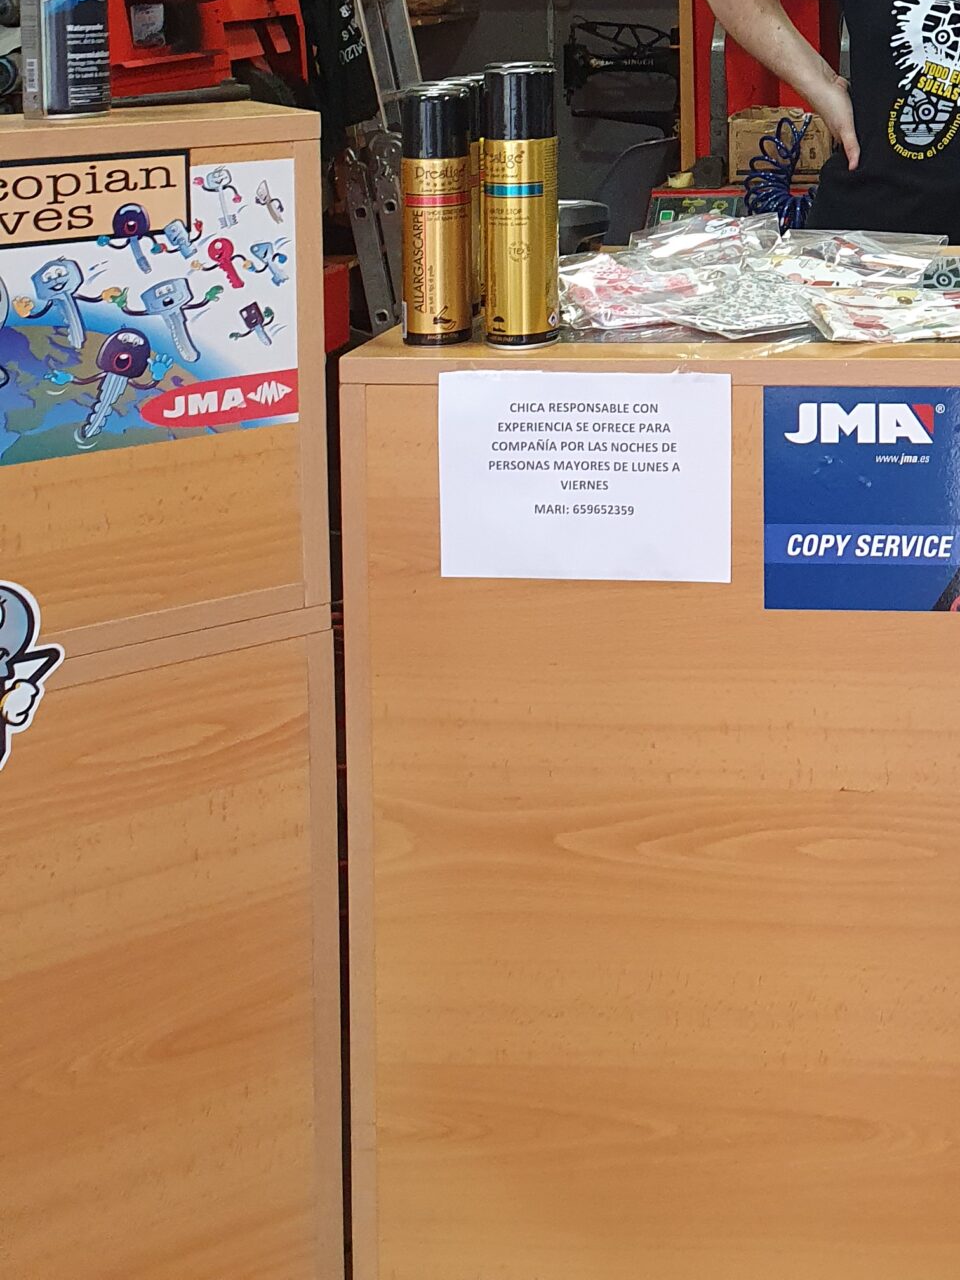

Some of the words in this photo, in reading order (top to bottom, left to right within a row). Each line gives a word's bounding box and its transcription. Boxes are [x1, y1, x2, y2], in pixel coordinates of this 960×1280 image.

[924, 60, 950, 81] TODO
[917, 76, 960, 101] SUELAS
[887, 111, 897, 145] pisada
[894, 143, 925, 160] marca
[926, 147, 937, 158] el
[0, 205, 94, 235] ves
[412, 210, 425, 314] ALLARGASCARPE
[163, 388, 247, 418] JMA
[509, 402, 545, 413] CHICA
[548, 402, 630, 414] RESPONSABLE
[632, 403, 658, 414] CON
[497, 422, 573, 432] EXPERIENCIA
[575, 422, 589, 432] SE
[592, 422, 636, 433] OFRECE
[638, 423, 671, 433] PARA
[784, 402, 935, 444] JMA
[491, 438, 558, 452] COMPAÑÍA
[560, 441, 585, 452] POR
[588, 441, 608, 452] LAS
[611, 442, 659, 453] NOCHES
[661, 442, 677, 453] DE
[488, 460, 550, 471] PERSONAS
[553, 460, 611, 472] MAYORES
[613, 461, 629, 472] DE
[631, 462, 669, 473] LUNES
[671, 462, 681, 472] A
[875, 452, 930, 465] www.jma.es
[560, 480, 609, 491] VIERNES
[534, 504, 570, 515] MARI:
[572, 504, 635, 516] 659652359
[787, 534, 852, 556] COPY
[855, 534, 954, 558] SERVICE
